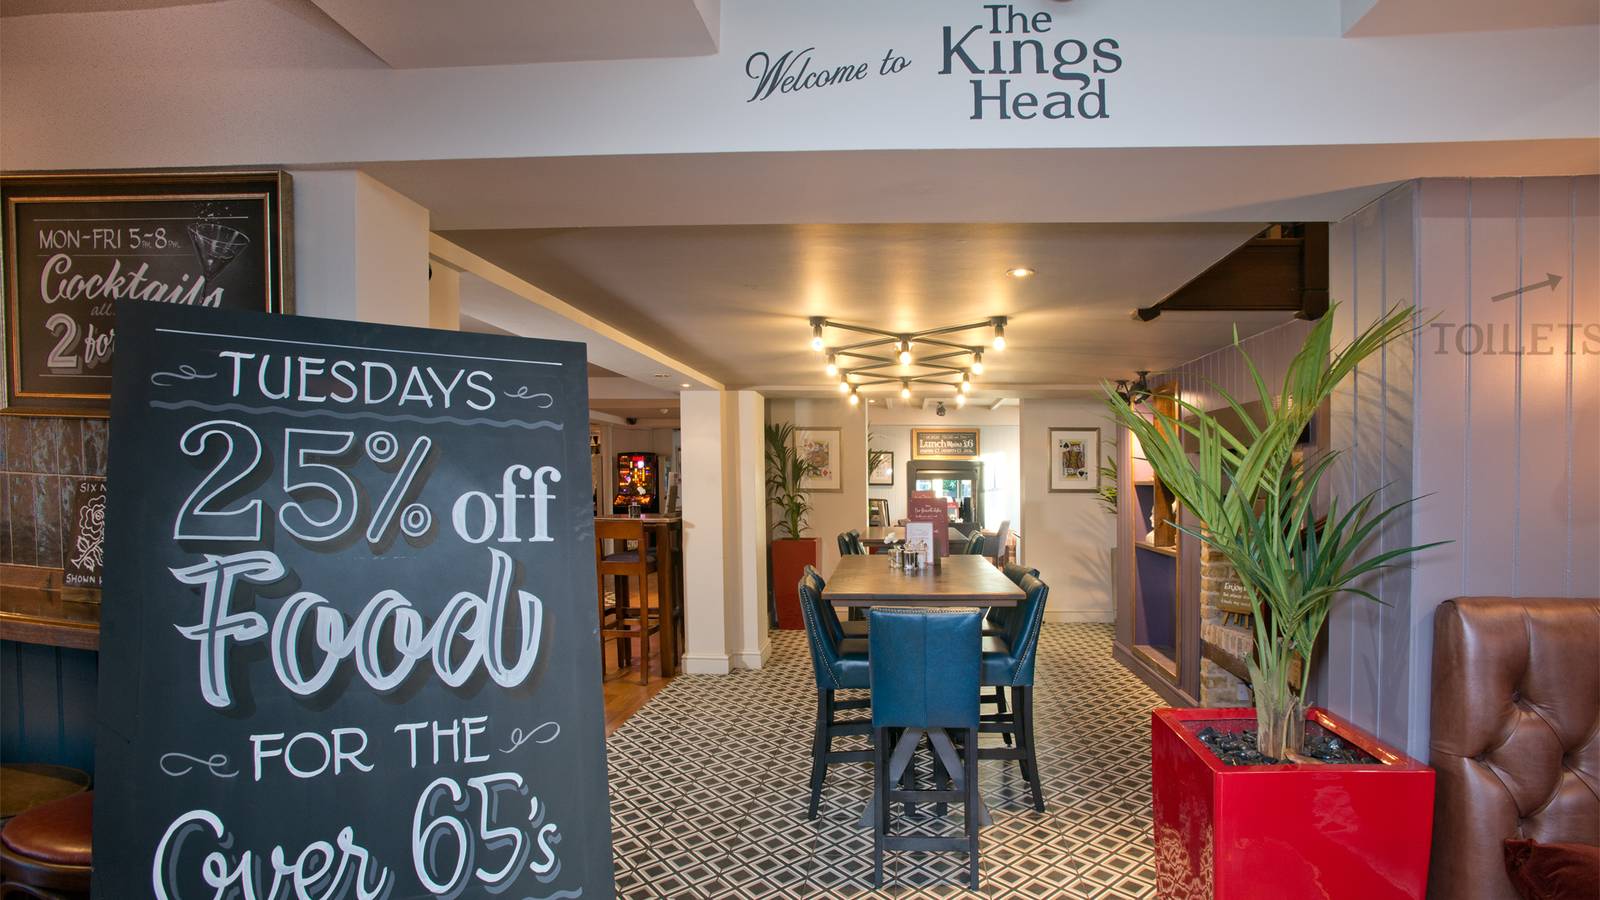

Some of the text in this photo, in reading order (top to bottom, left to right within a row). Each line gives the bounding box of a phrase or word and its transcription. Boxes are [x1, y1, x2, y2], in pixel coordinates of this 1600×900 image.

[983, 4, 1052, 34] The
[745, 47, 911, 103] Welcome to
[938, 25, 1122, 91] Kings
[970, 79, 1110, 120] Head
[39, 228, 121, 249] MON-FRI
[41, 253, 225, 308] Cocktails
[45, 313, 79, 369] 2
[1430, 323, 1600, 356] TOILETS
[219, 351, 496, 411] TUESDAYS
[919, 439, 947, 448] Lunch
[80, 482, 97, 493] SIX
[173, 419, 561, 544] 25% off
[66, 573, 96, 584] SHOWN
[1224, 582, 1243, 593] Enjoy
[167, 546, 543, 707] Food
[249, 716, 490, 781] FOR THE
[152, 772, 558, 900] Over 65's
